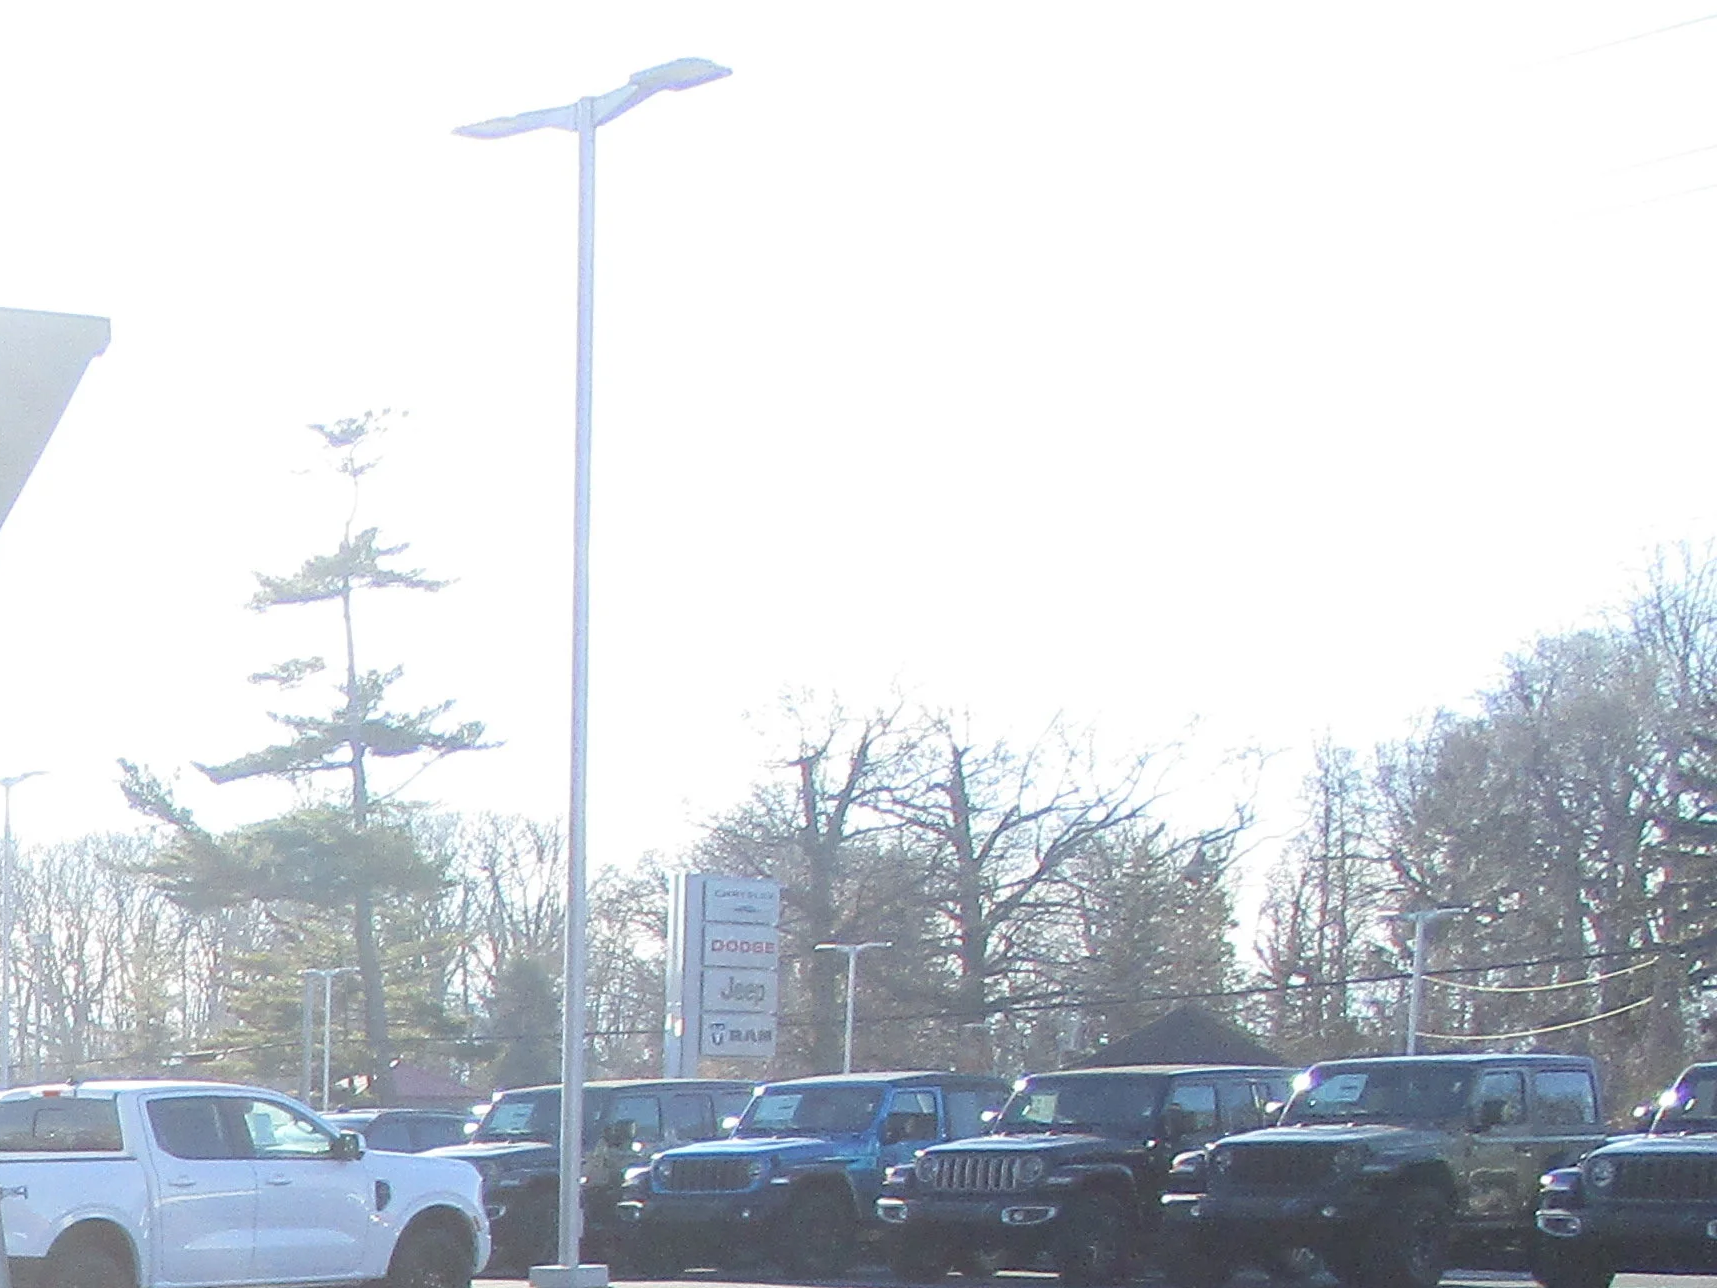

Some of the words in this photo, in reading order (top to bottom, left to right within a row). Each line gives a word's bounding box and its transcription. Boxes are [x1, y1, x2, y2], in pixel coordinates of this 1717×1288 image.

[711, 939, 776, 954] DODGE
[720, 976, 766, 1005] Jeep
[728, 1029, 773, 1043] RAM
